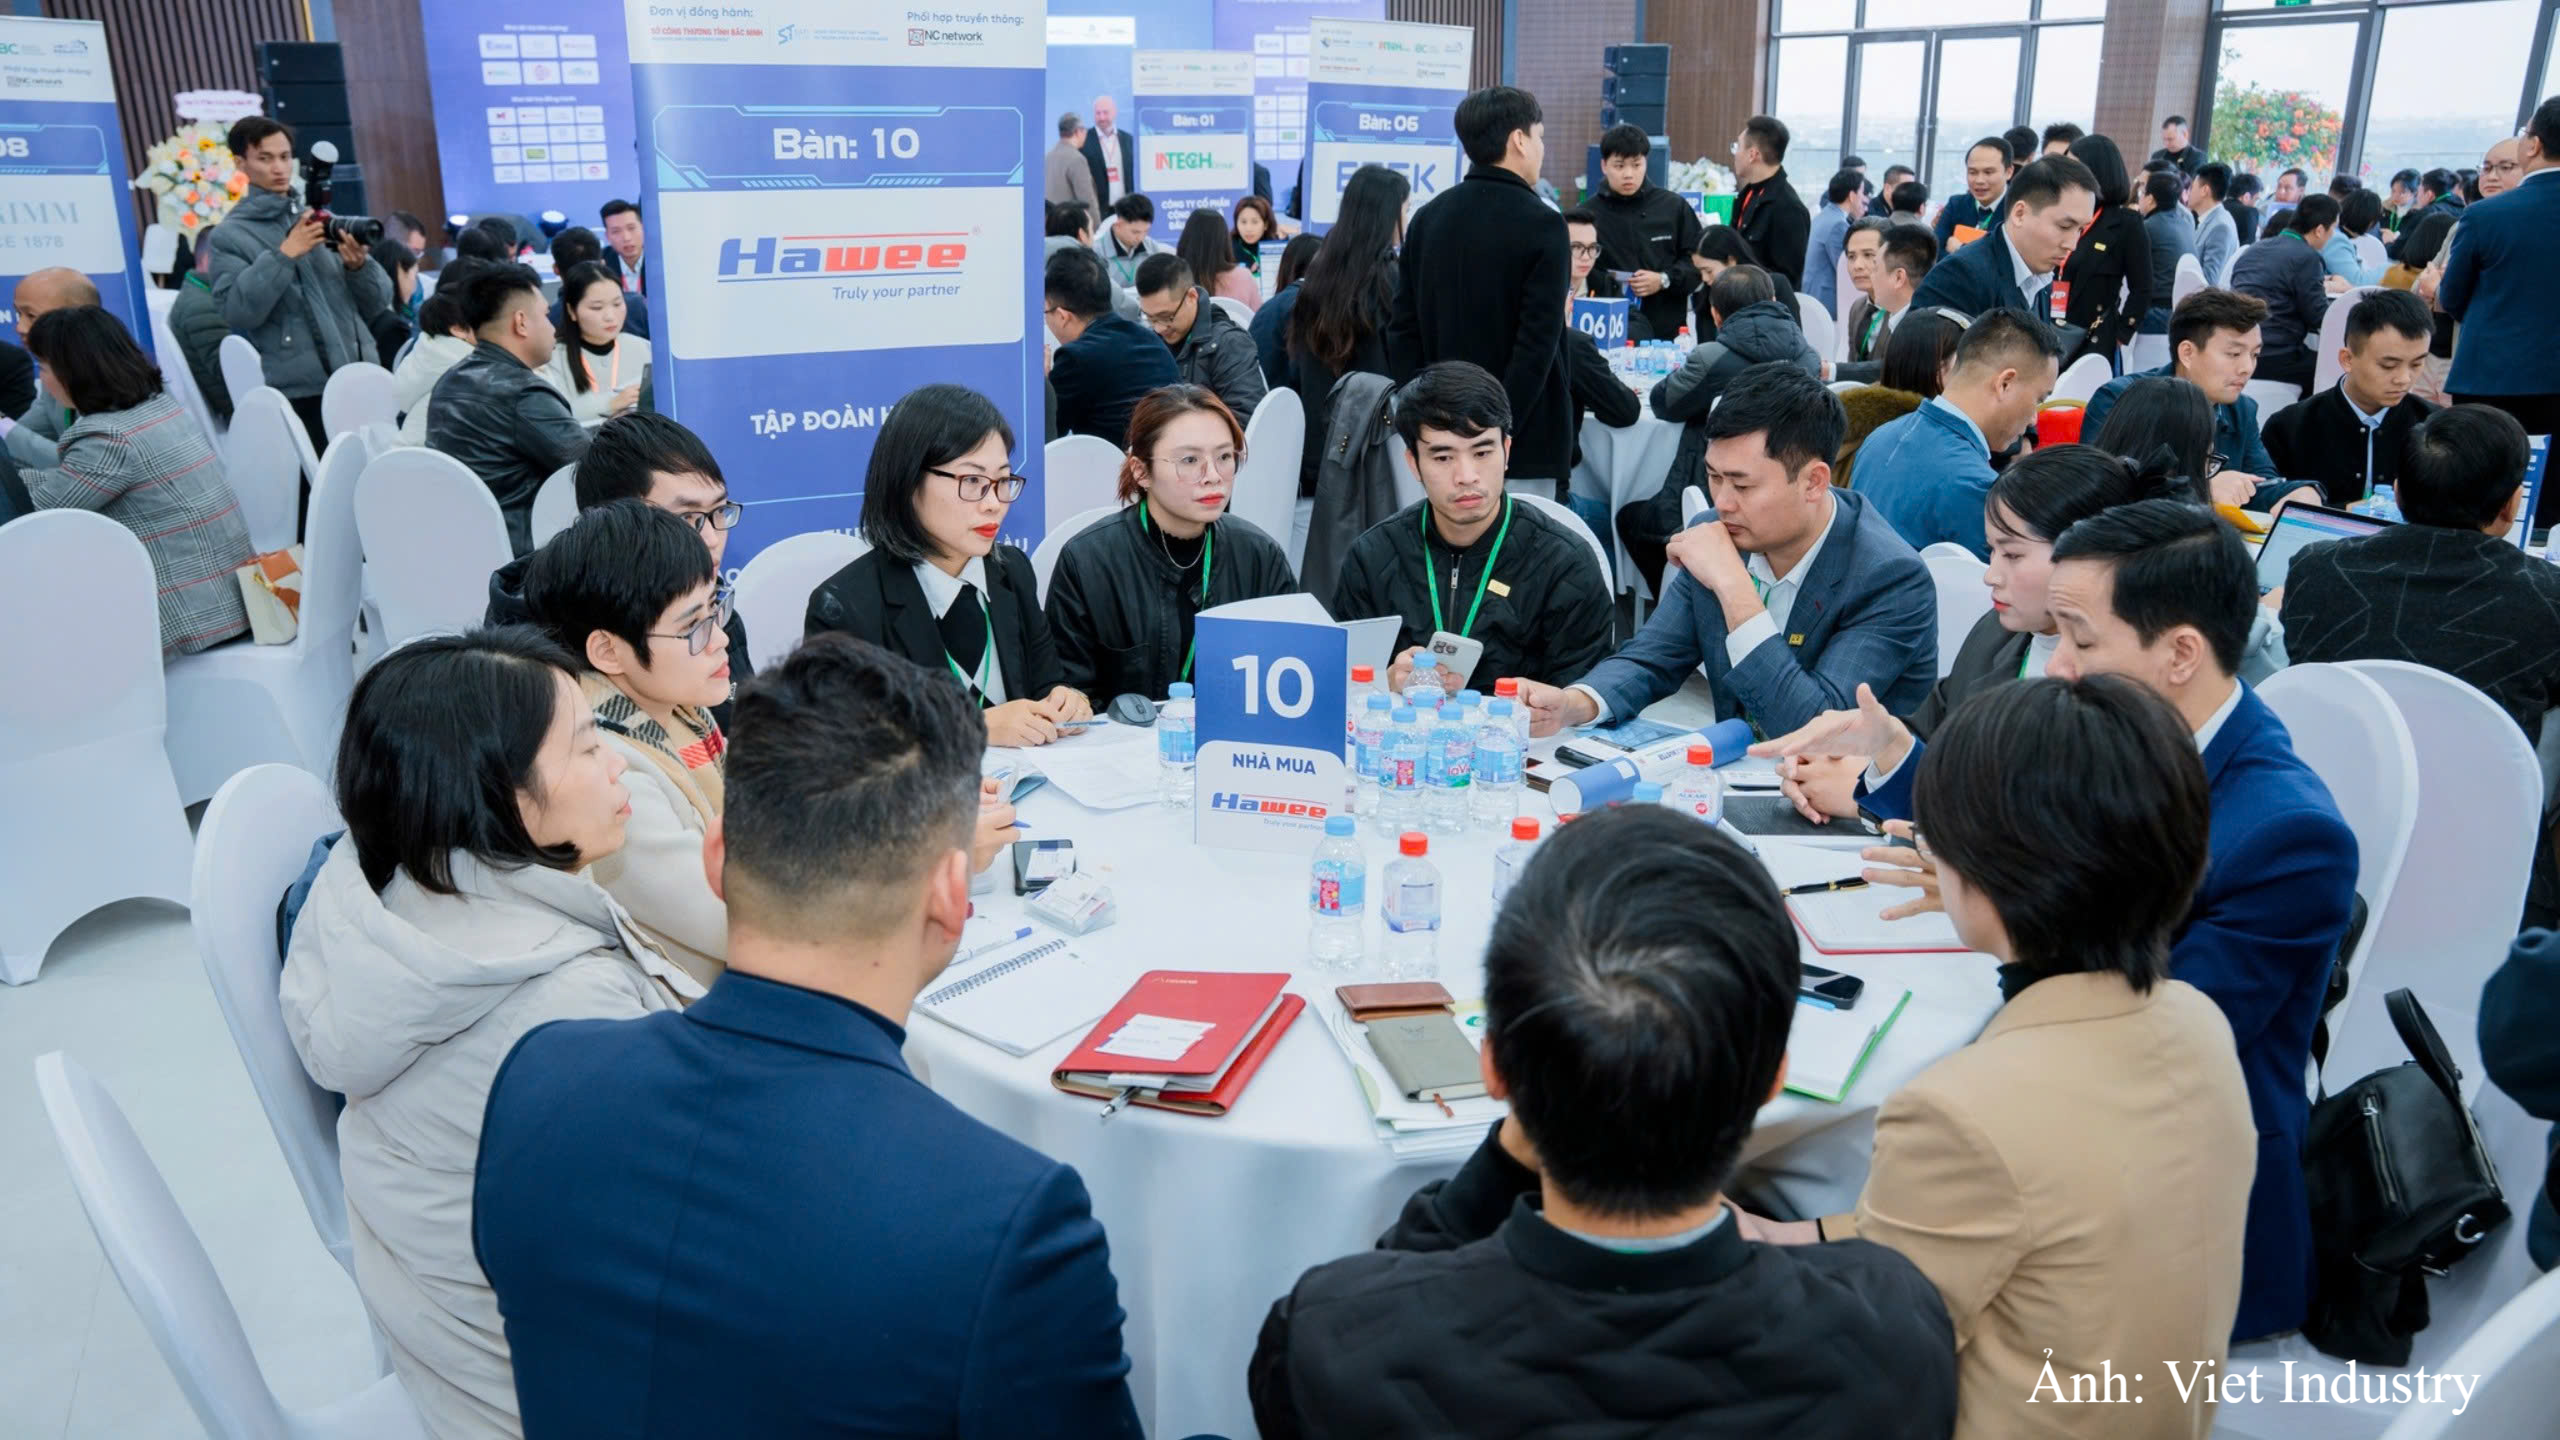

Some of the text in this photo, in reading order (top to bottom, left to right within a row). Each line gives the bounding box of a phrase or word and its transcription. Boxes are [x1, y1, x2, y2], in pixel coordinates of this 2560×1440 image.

[907, 11, 930, 22] Phối
[933, 12, 953, 24] hợp
[956, 12, 989, 25] truyền
[924, 30, 983, 42] NC network
[1200, 114, 1215, 127] 01
[1359, 112, 1420, 132] Bàn: 06
[773, 127, 920, 160] Bàn: 10
[1155, 152, 1213, 170] INTECH
[0, 200, 80, 225] IMM
[718, 236, 967, 276] Hawee
[832, 284, 960, 301] Truly your partner
[1580, 312, 1606, 339] 06
[1609, 312, 1624, 339] 06
[750, 408, 796, 440] TẬP
[802, 403, 874, 431] ĐOÀN
[1232, 655, 1315, 718] 10
[1232, 752, 1316, 775] NHÀ MUA
[1212, 793, 1327, 819] Hawee
